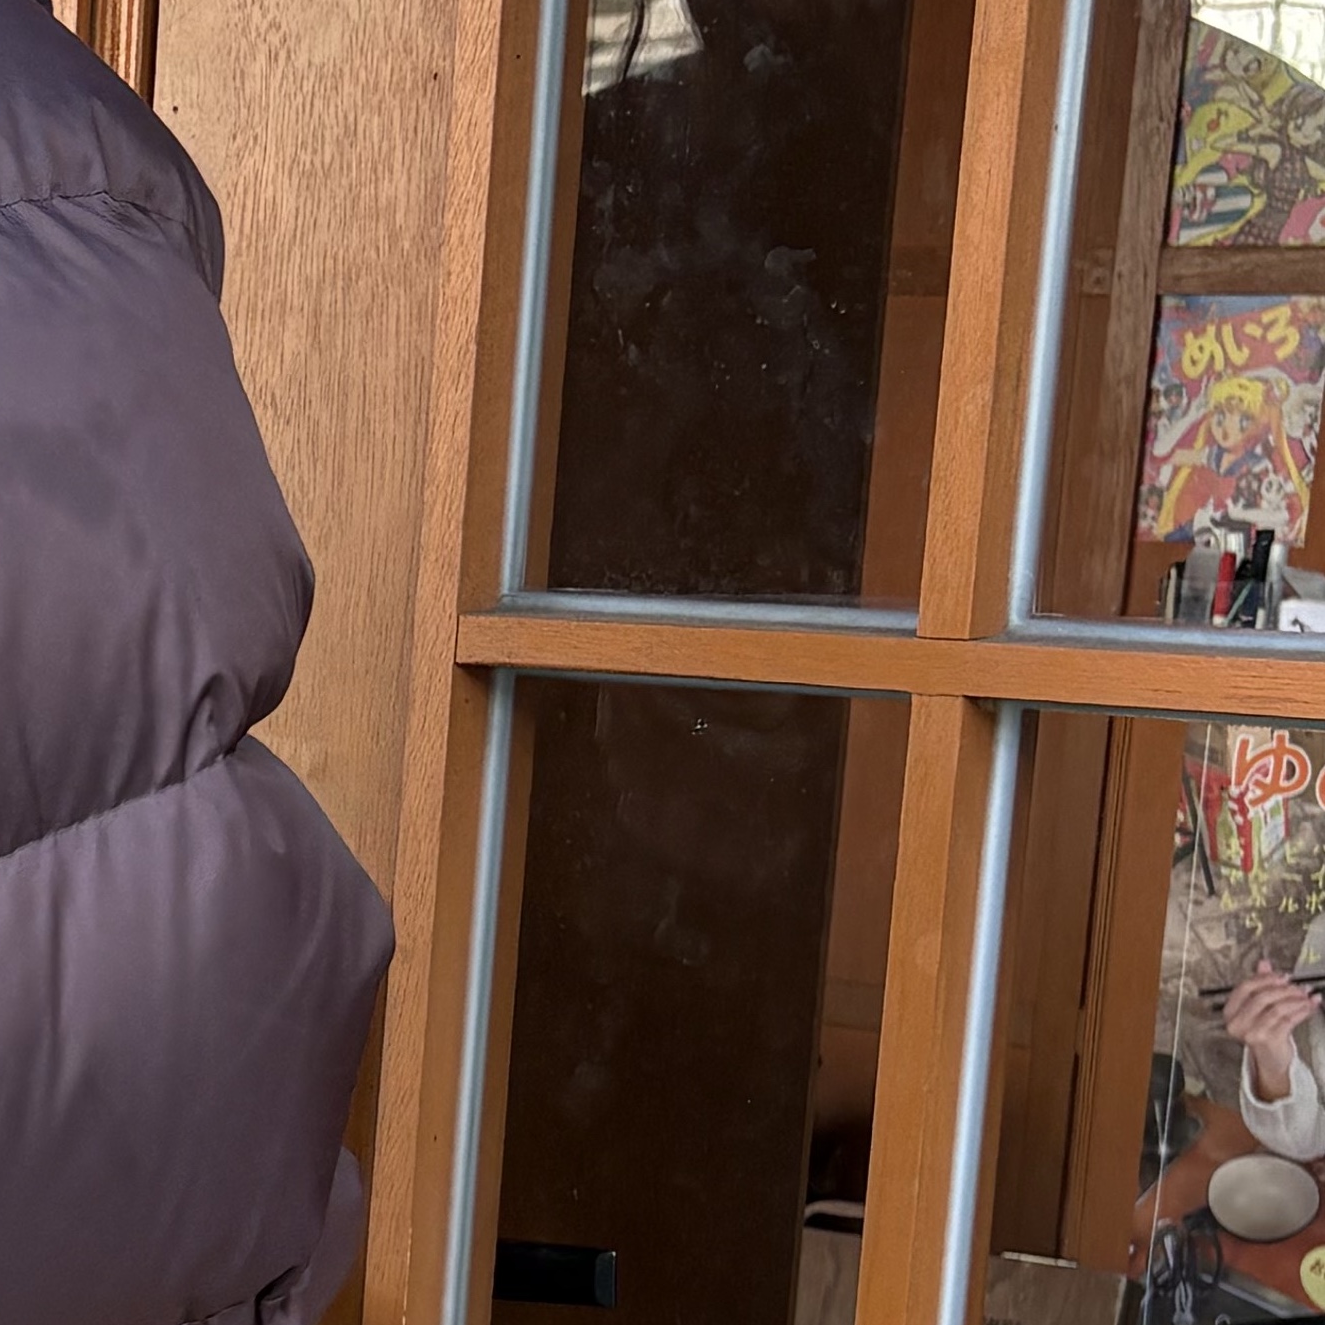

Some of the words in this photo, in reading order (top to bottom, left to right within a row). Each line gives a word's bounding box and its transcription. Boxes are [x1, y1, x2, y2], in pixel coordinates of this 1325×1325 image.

[1182, 305, 1300, 379] めいろ
[1230, 729, 1325, 810] ゆ
